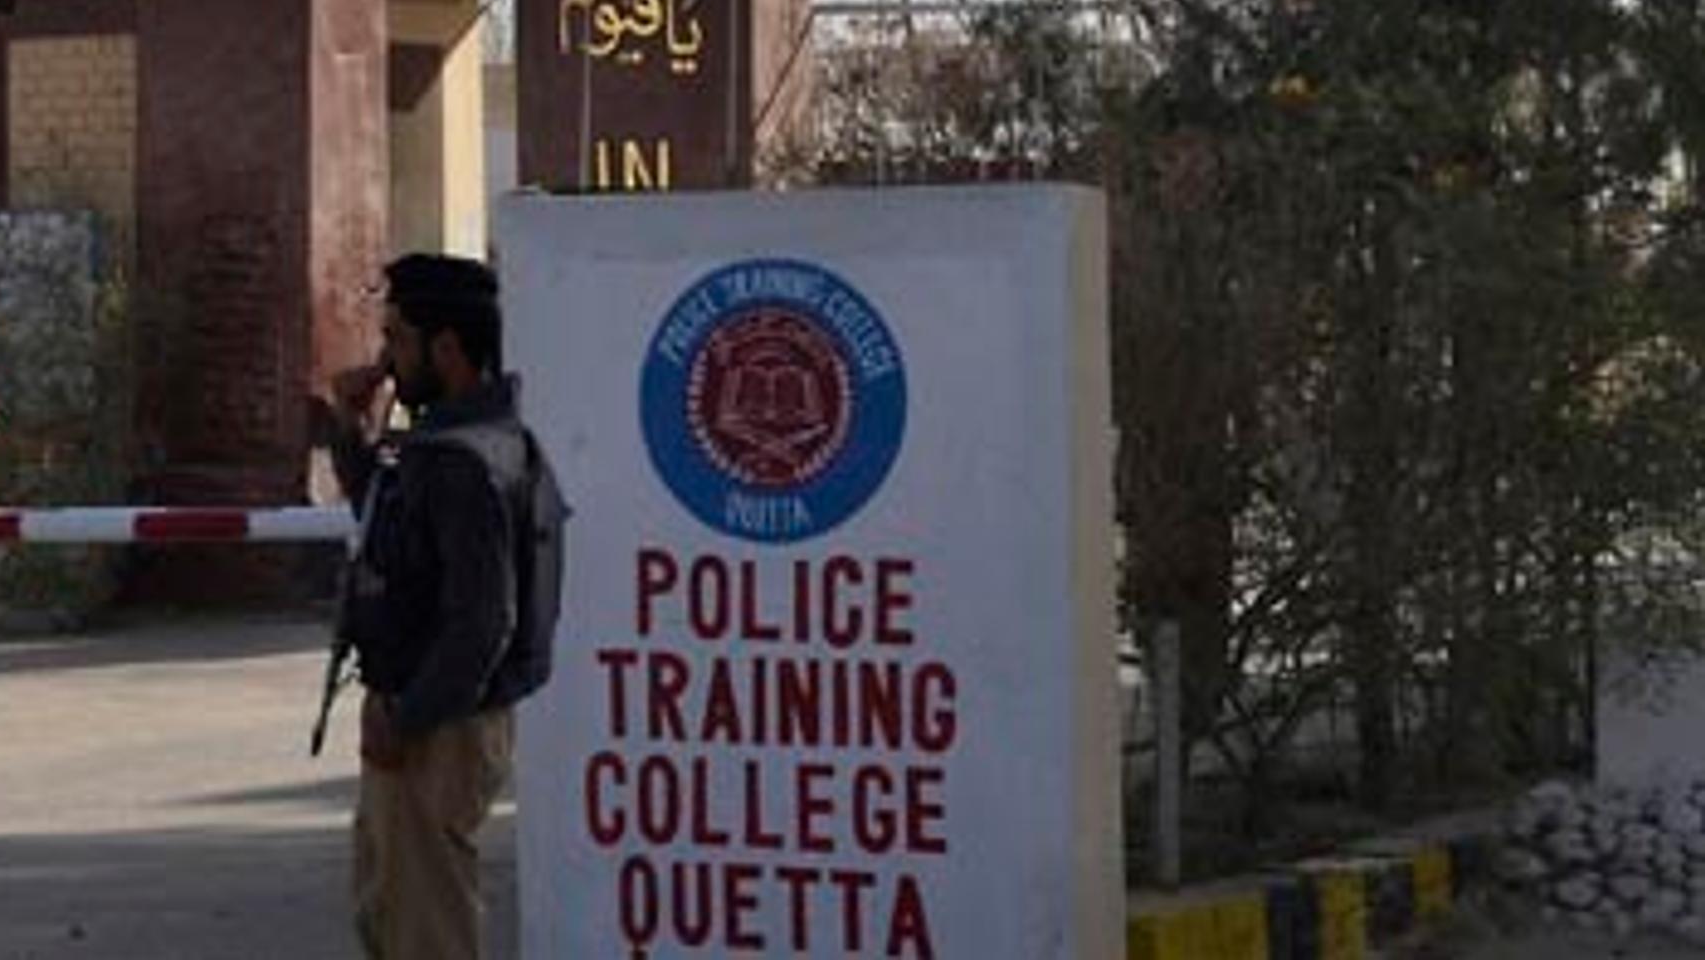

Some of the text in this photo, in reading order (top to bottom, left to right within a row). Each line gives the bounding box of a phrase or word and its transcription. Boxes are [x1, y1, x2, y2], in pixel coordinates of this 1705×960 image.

[597, 139, 670, 189] IN
[635, 548, 916, 648] POLICE
[596, 648, 958, 755] TRAINING
[584, 749, 948, 855] COLLEGE
[618, 853, 936, 960] QUETTA
